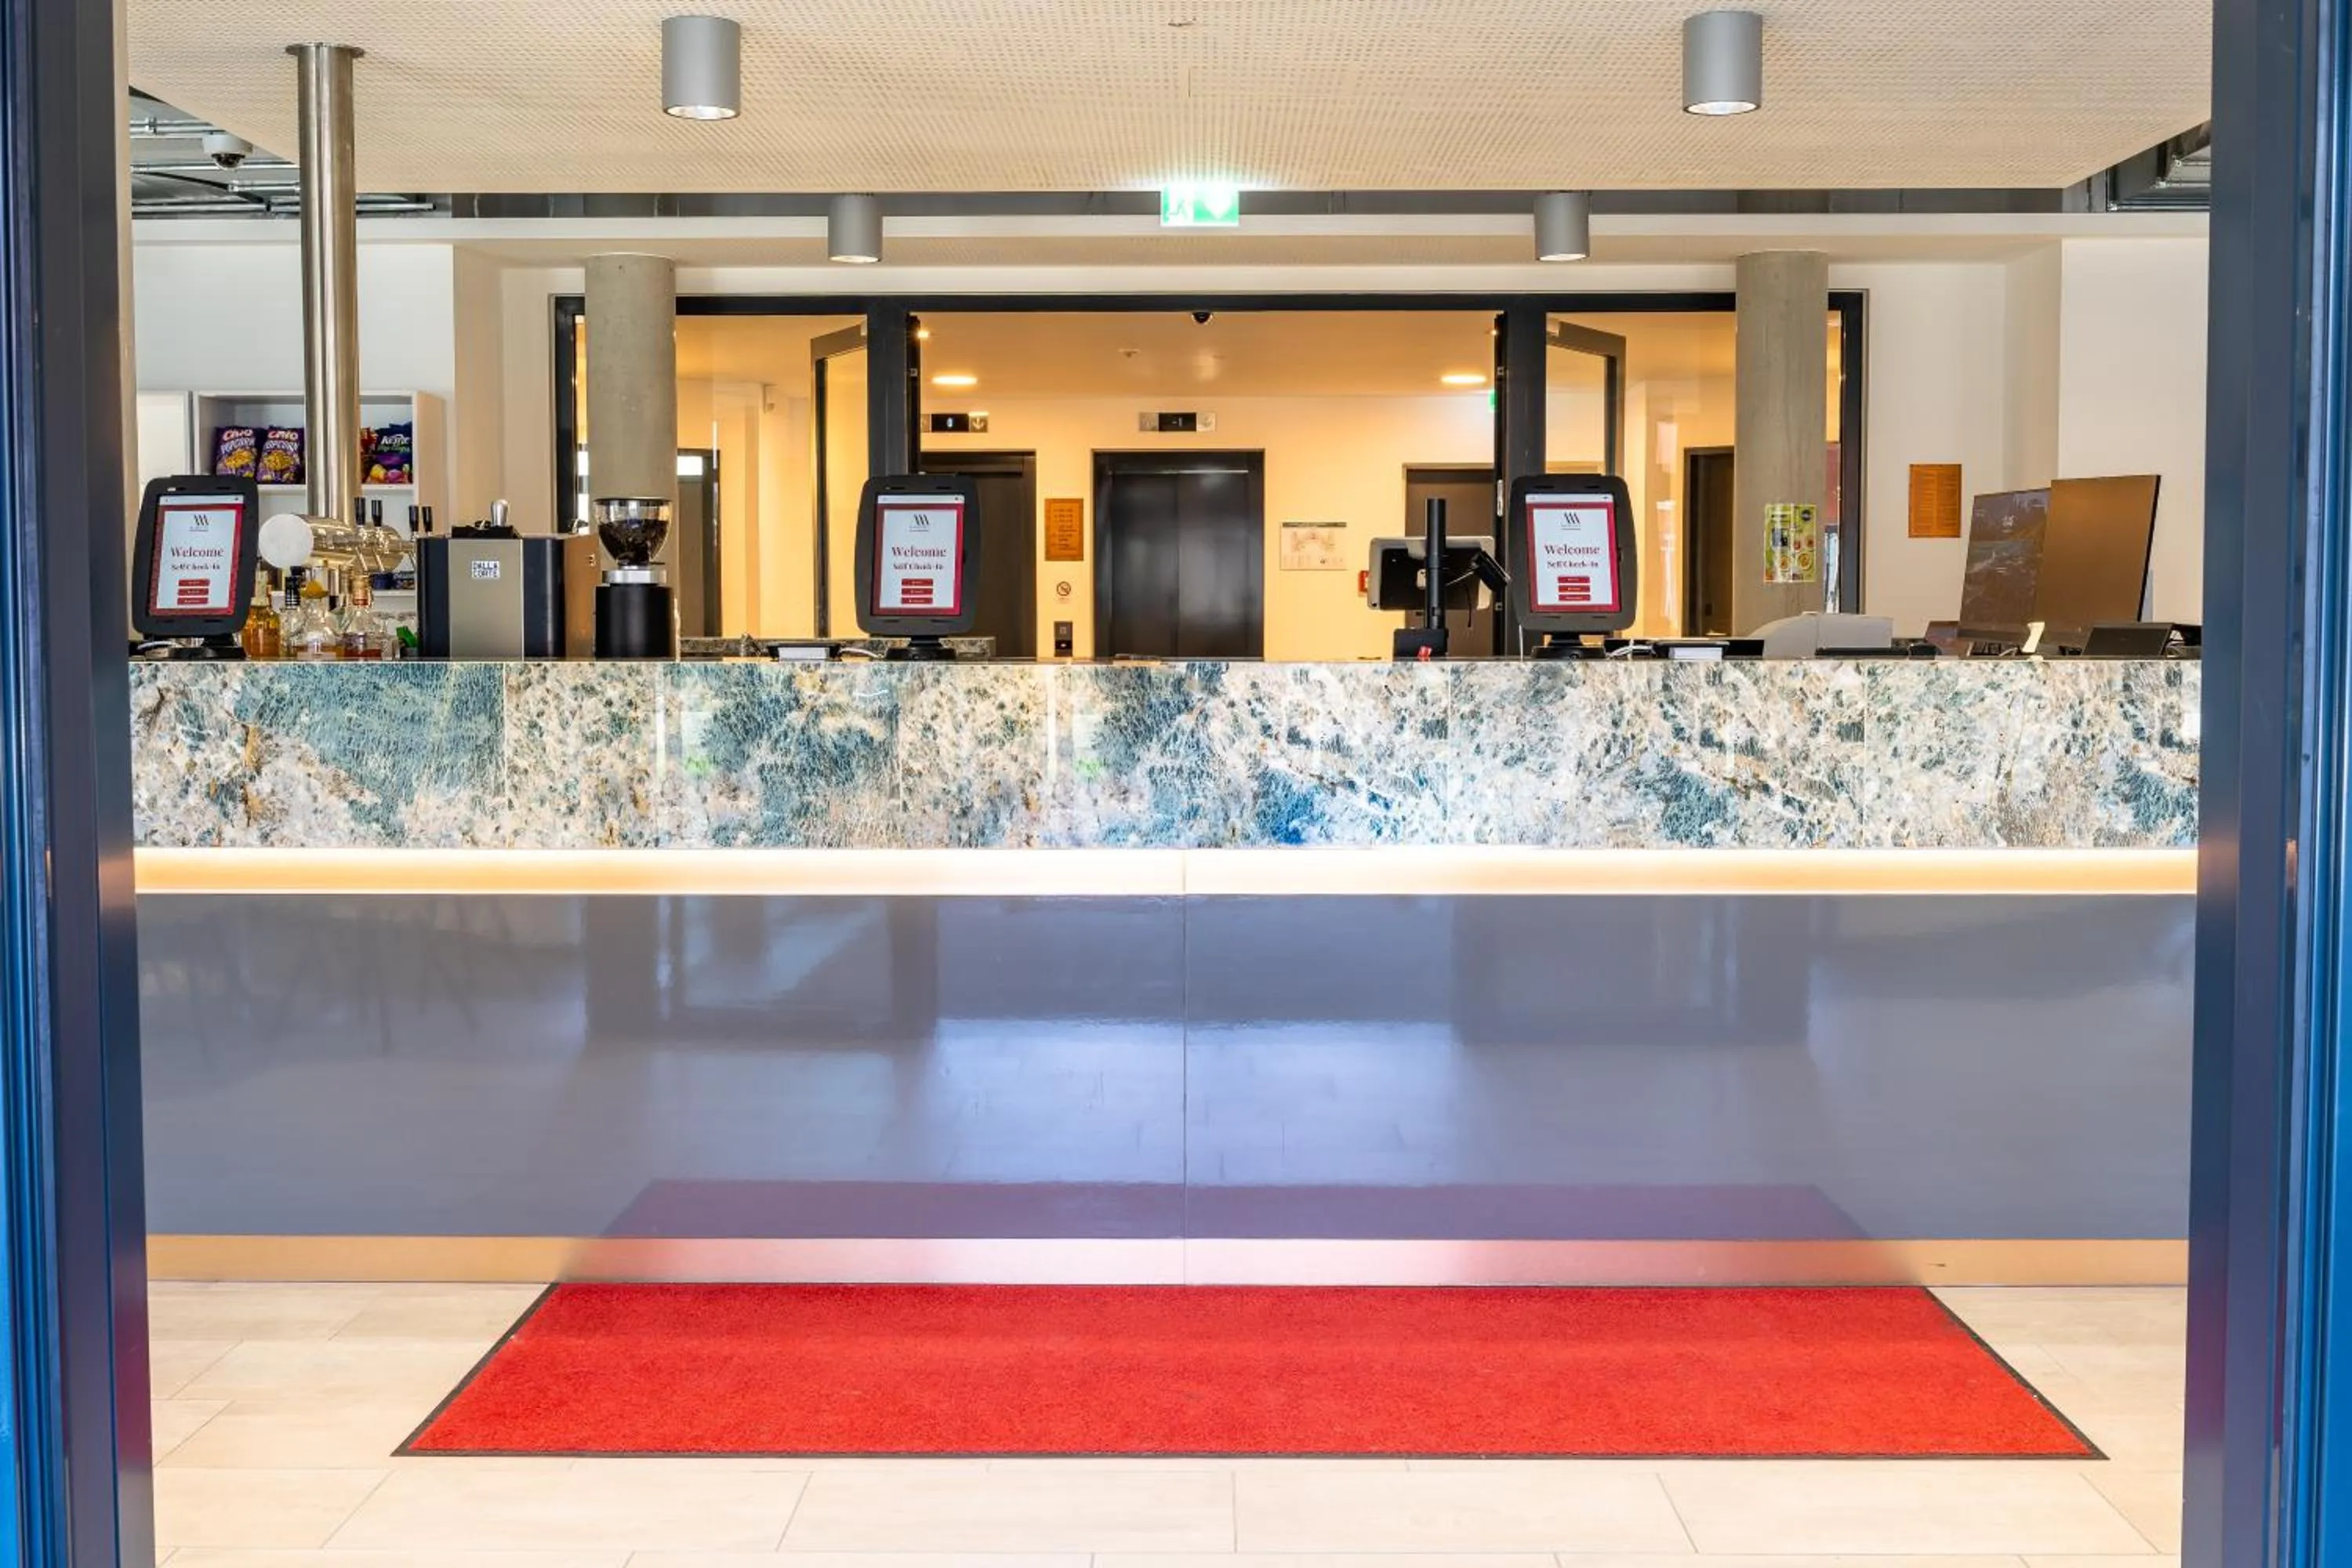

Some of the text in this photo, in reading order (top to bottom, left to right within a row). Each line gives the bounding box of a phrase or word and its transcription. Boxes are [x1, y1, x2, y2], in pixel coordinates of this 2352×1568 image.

[170, 546, 225, 557] Welcome
[891, 546, 947, 557] Welcome
[1544, 543, 1600, 555] Welcome
[171, 562, 187, 571] Self
[1547, 560, 1563, 568] Self
